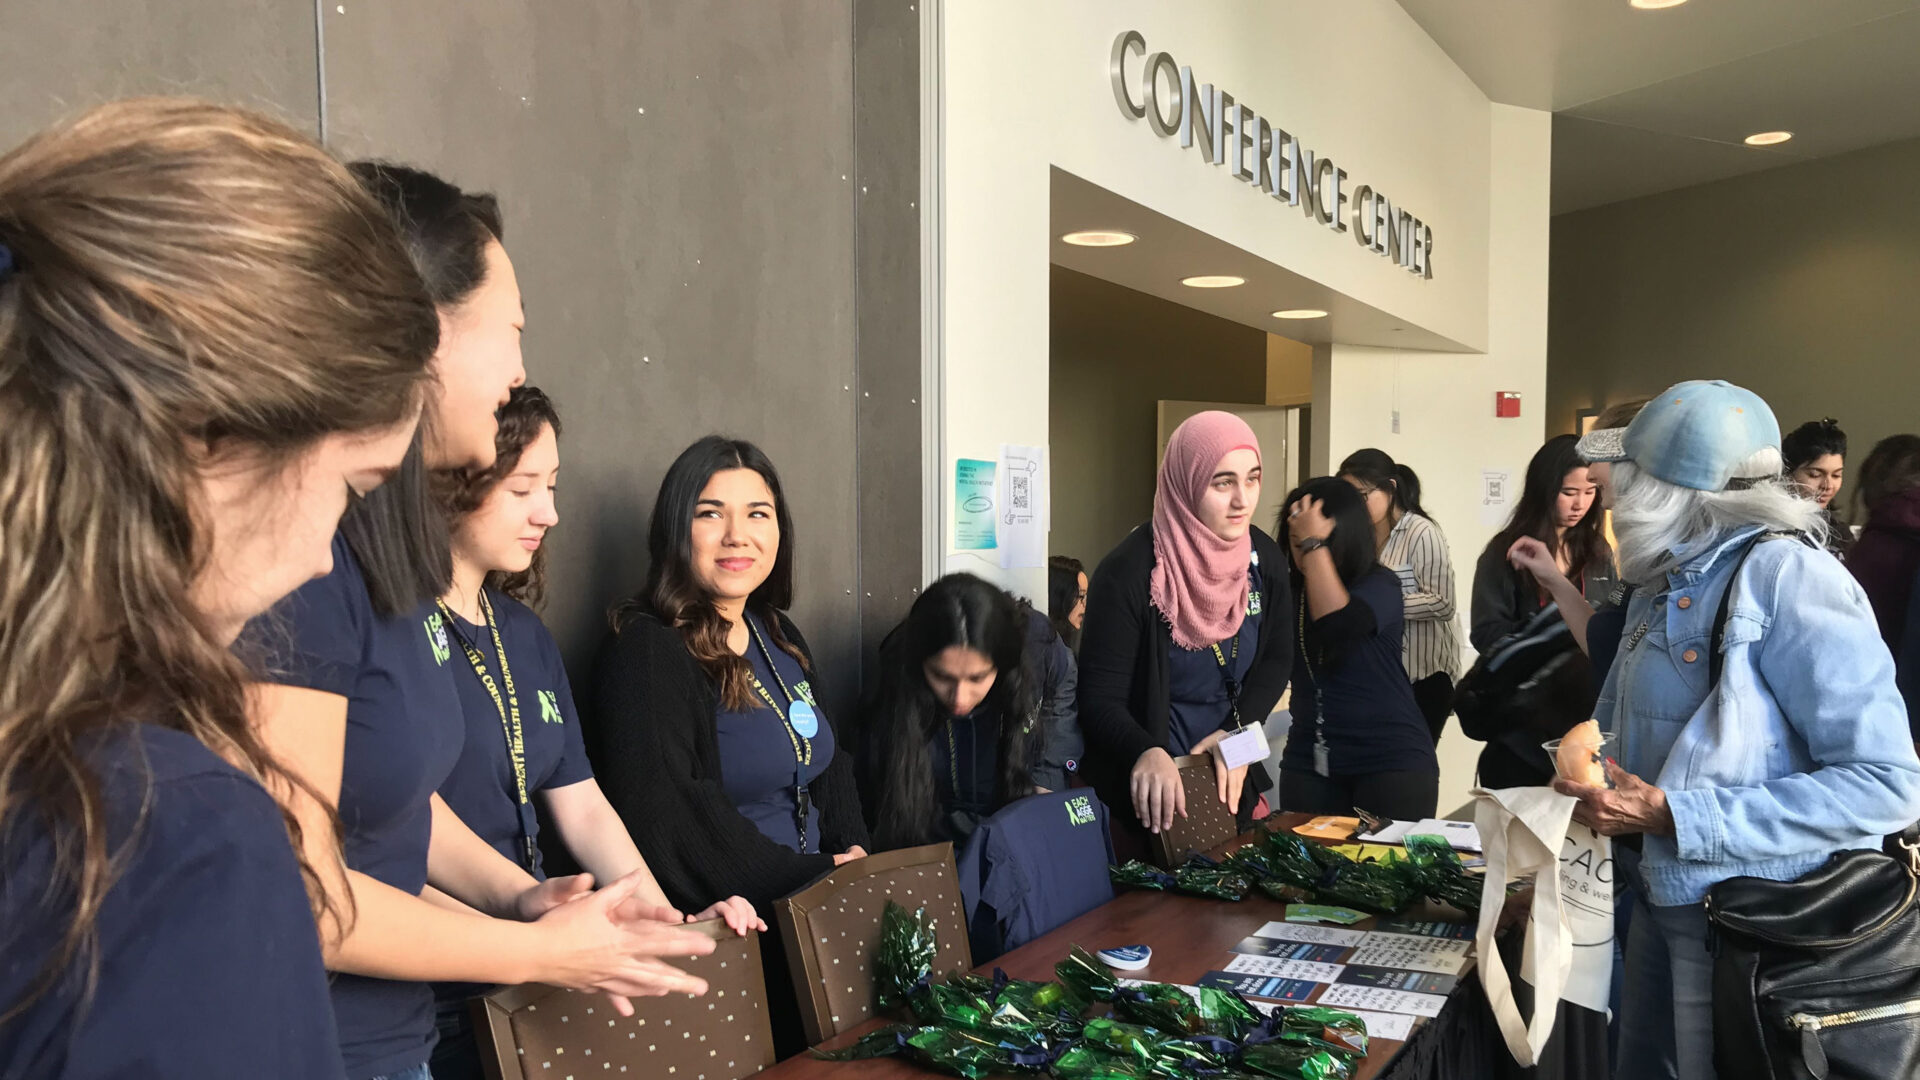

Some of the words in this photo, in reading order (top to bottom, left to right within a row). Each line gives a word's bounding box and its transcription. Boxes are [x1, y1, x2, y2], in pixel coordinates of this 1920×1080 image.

[1110, 30, 1347, 233] CONFERENCE
[1352, 185, 1433, 280] CENTER
[492, 628, 515, 694] COUNSELING
[511, 708, 524, 753] HEALTH
[1579, 882, 1590, 894] &
